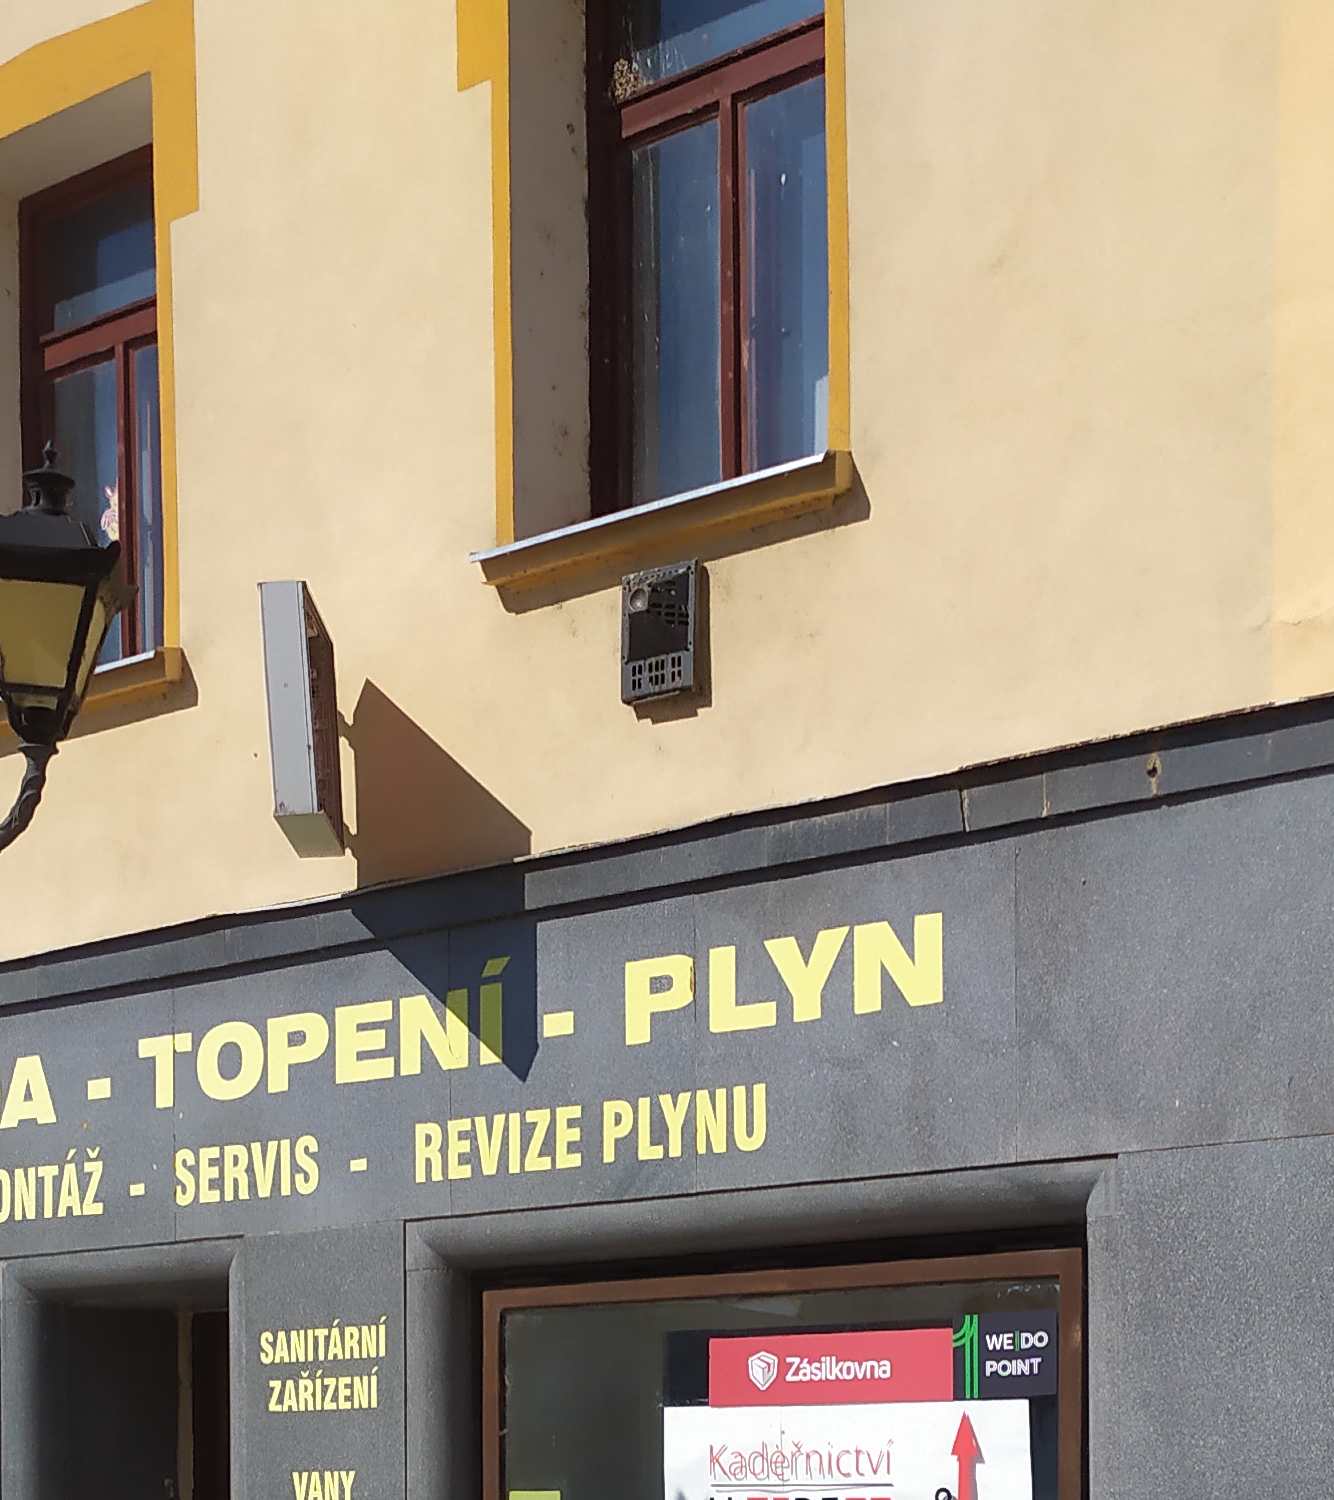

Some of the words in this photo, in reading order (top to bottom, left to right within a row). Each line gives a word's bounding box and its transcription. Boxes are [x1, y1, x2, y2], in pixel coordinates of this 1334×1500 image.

[138, 956, 511, 1109] TOPENÍ
[624, 911, 944, 1046] PLYN
[174, 1134, 320, 1207] SERVIS
[414, 1105, 582, 1185] REVIZE
[602, 1082, 767, 1164] PLYNU
[259, 1315, 387, 1365] SANITÁRNÍ
[268, 1365, 378, 1413] ZAŘÍZENÍ
[785, 1356, 891, 1383] Zásilkovna
[985, 1357, 1042, 1377] POINT
